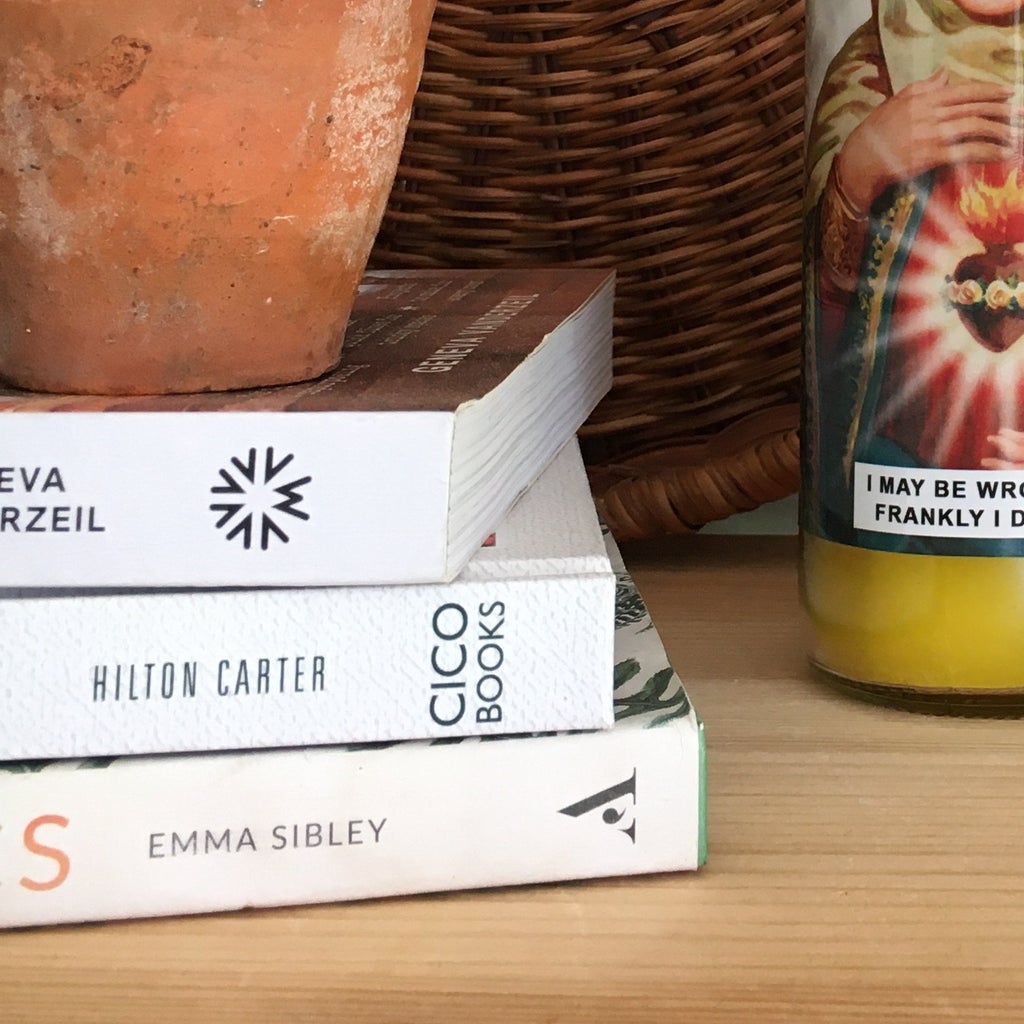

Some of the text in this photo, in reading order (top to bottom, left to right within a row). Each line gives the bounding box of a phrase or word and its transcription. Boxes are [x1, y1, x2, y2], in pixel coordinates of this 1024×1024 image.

[411, 336, 487, 373] GENEVA
[0, 466, 66, 493] EVA
[866, 473, 873, 492] I
[879, 475, 925, 497] MAY
[934, 479, 967, 499] BE
[0, 506, 106, 533] RZEIL
[875, 502, 985, 528] FRANKLY
[993, 509, 1000, 528] I
[93, 655, 326, 702] HILTON CARTER
[429, 602, 469, 728] CICO
[475, 600, 506, 724] BOOKS
[148, 817, 389, 859] EMMA SIBLEY
